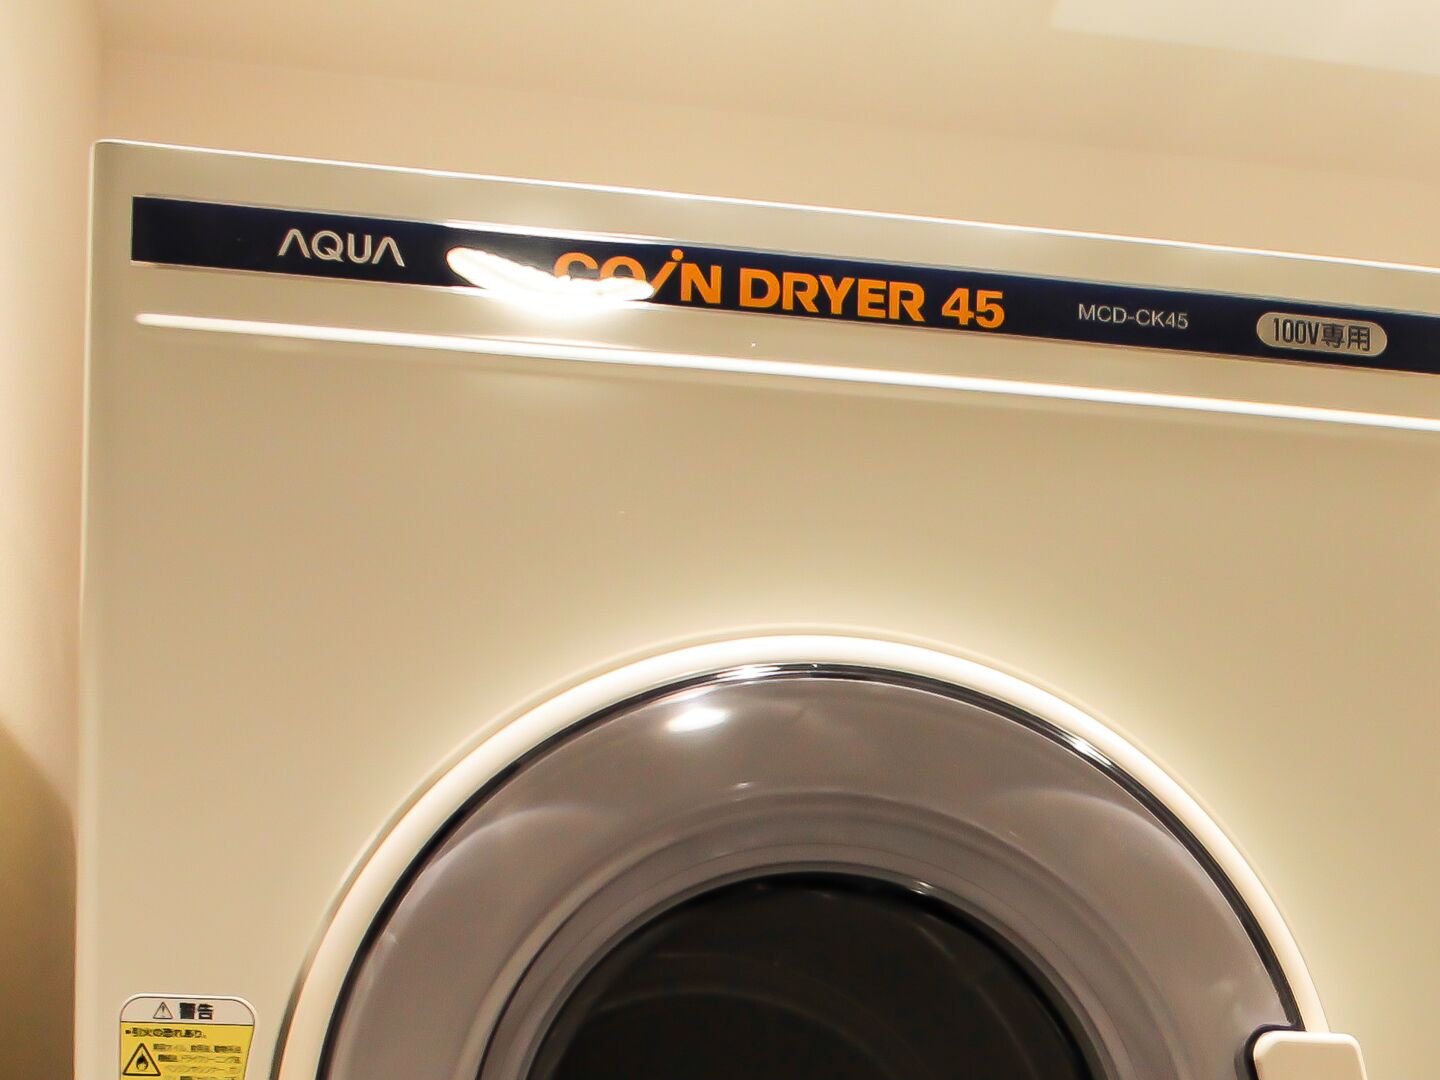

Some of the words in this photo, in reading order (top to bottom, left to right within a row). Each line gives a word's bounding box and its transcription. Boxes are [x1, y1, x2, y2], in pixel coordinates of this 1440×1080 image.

[278, 228, 405, 268] AQUA
[738, 266, 926, 323] DRYER
[941, 287, 1005, 329] 45
[1078, 303, 1189, 330] MCD-CK45
[1272, 317, 1371, 353] 100V専用
